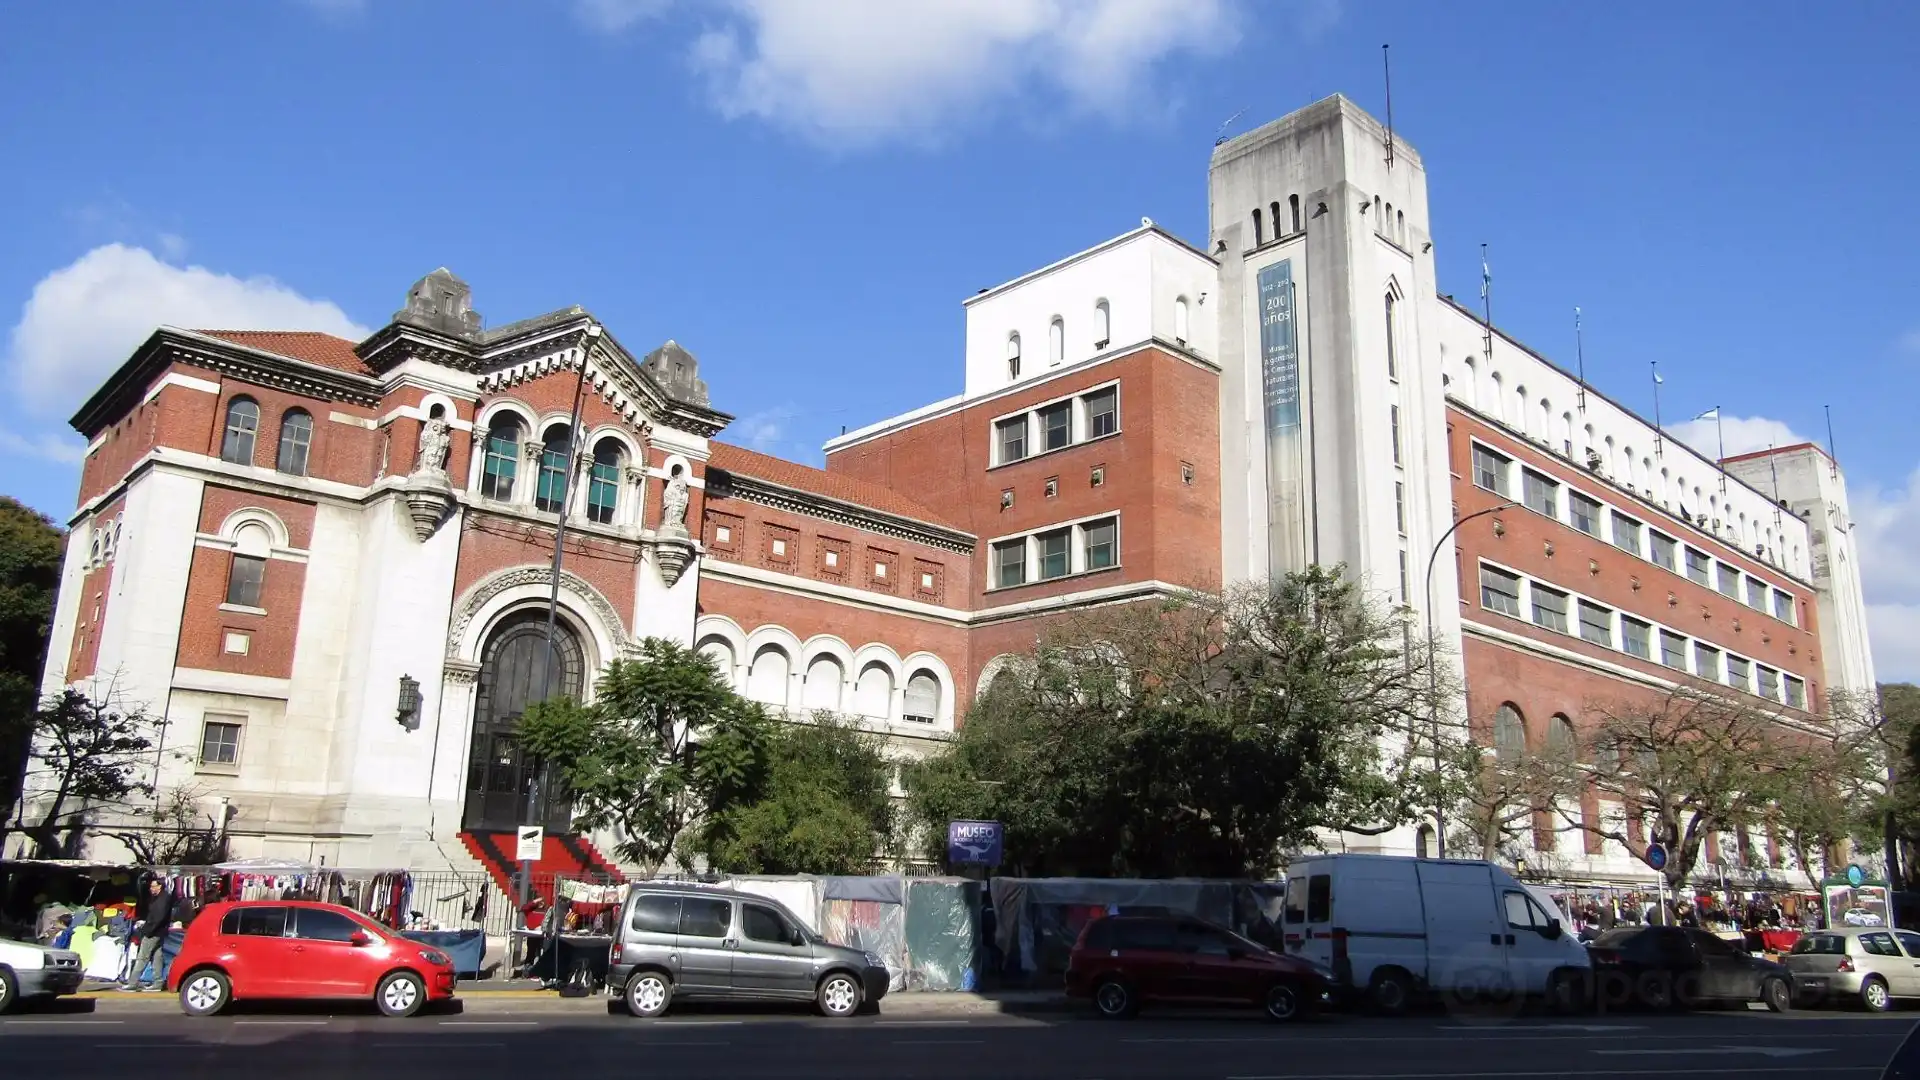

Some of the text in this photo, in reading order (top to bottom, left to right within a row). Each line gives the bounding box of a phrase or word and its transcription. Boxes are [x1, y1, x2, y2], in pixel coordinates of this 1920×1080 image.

[1266, 295, 1286, 311] 200
[1264, 310, 1290, 327] años
[957, 826, 995, 838] MUSEO
